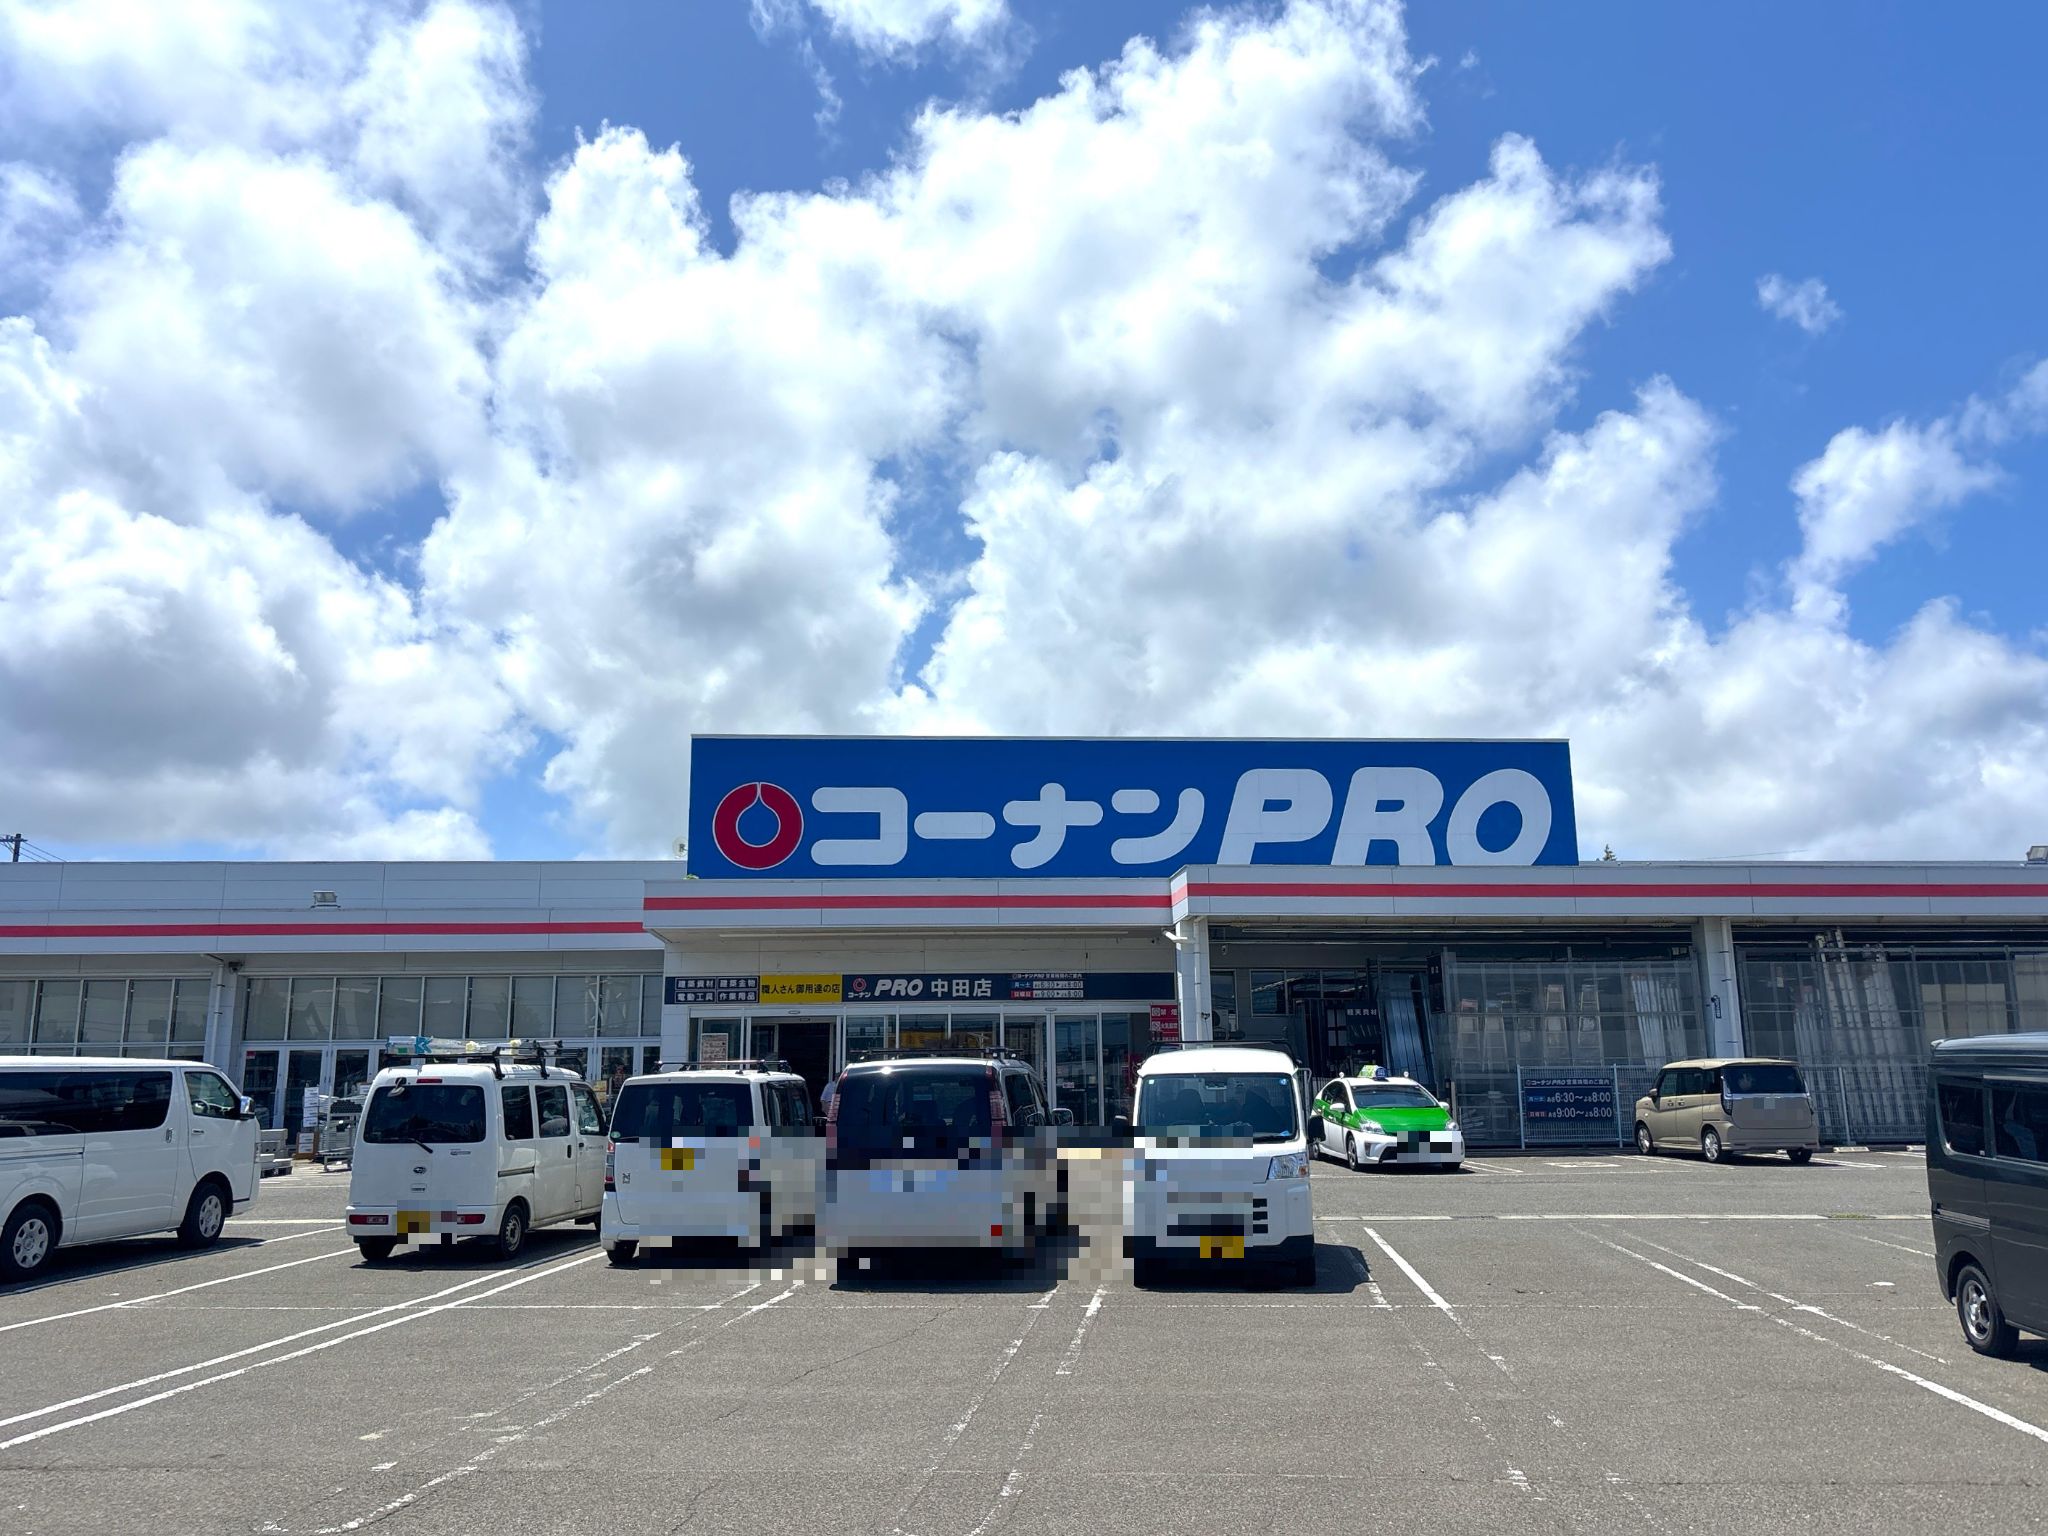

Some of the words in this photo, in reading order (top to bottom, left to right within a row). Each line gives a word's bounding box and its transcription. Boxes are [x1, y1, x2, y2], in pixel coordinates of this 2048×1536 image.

[677, 980, 714, 989] 建築資材
[719, 979, 756, 988] 建築金物
[874, 978, 924, 997] PRO
[930, 978, 992, 998] 中田店
[761, 983, 841, 994] 職人さん御用達の店
[677, 993, 714, 1001] 電動工具
[719, 992, 756, 1001] 作業用品
